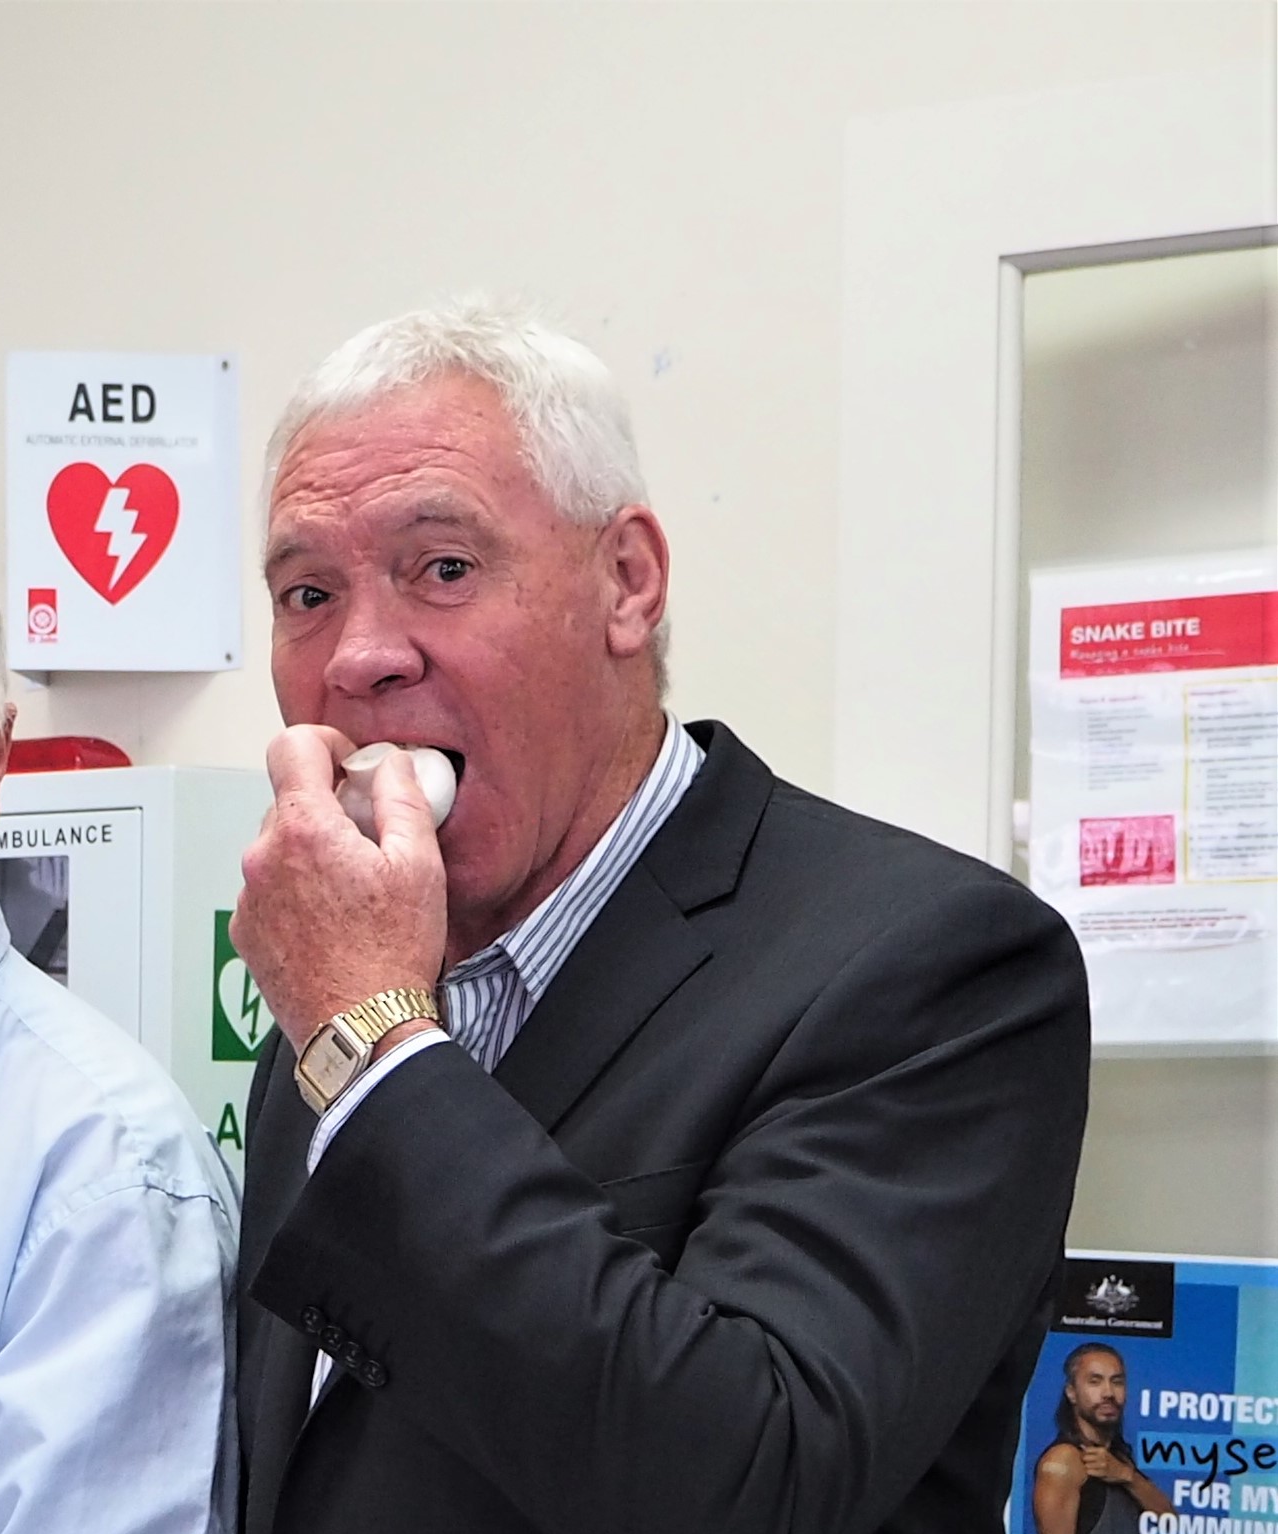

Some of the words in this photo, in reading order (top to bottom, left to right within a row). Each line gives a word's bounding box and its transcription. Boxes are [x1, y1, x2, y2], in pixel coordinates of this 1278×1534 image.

[68, 382, 157, 423] AED
[1070, 622, 1145, 644] SNAKE
[1151, 617, 1201, 638] BITE
[1060, 1315, 1106, 1327] Australian
[1107, 1317, 1164, 1330] Government
[1140, 1388, 1151, 1417] I
[1159, 1390, 1278, 1426] PROTEC
[1173, 1478, 1230, 1511] FOR
